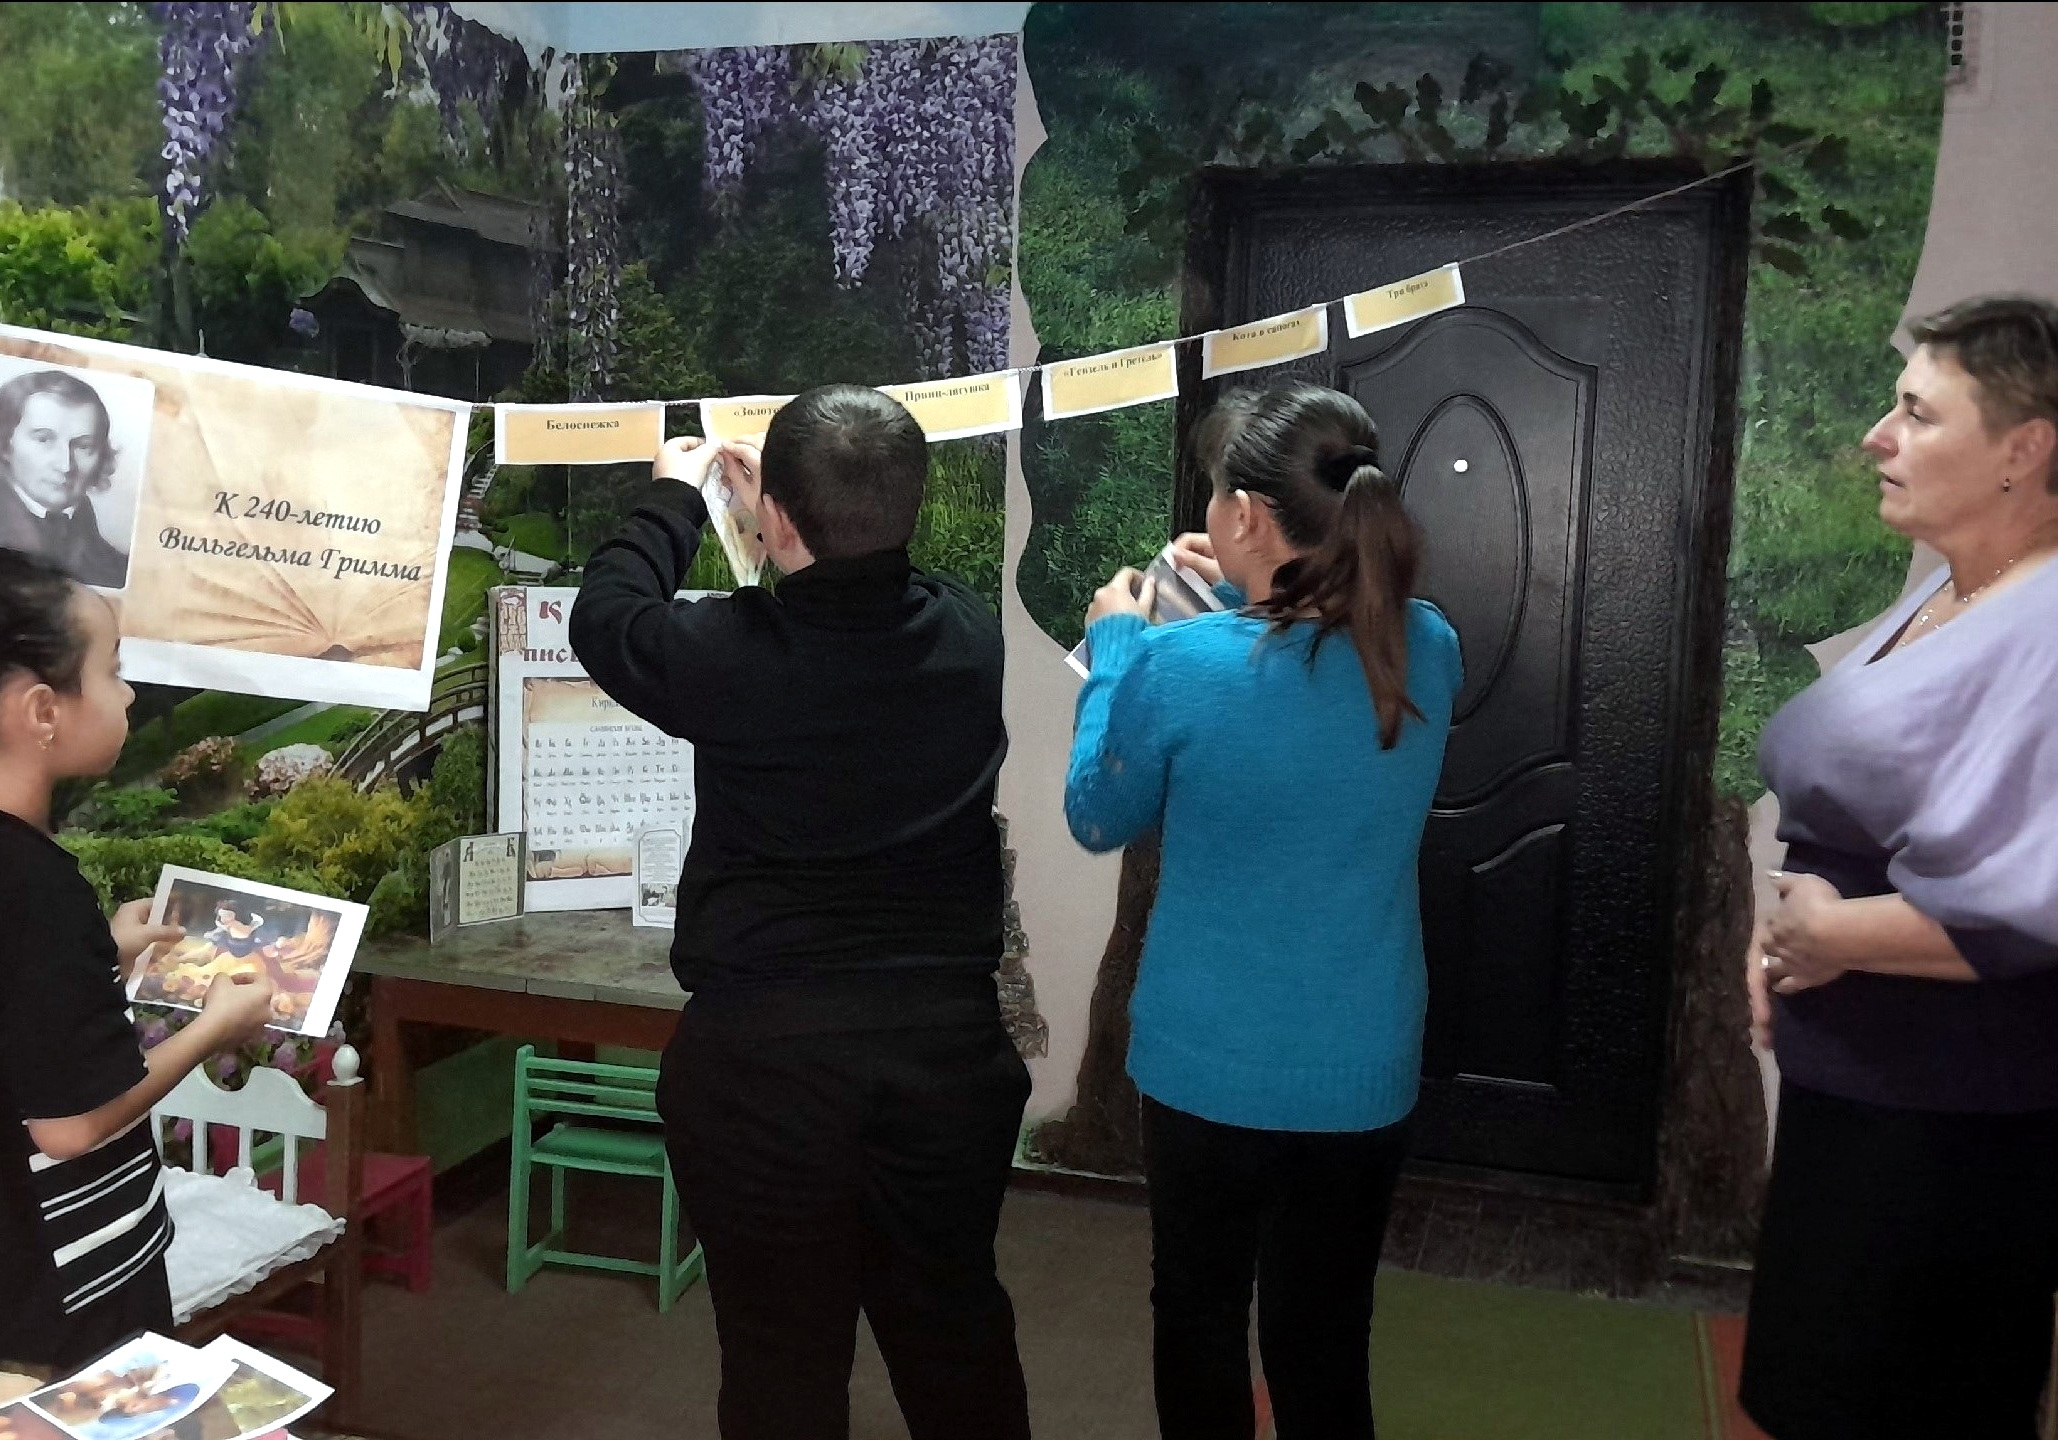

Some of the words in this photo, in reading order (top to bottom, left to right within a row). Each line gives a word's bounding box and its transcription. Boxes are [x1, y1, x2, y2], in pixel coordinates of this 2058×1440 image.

[1111, 361, 1118, 370] и
[546, 419, 620, 431] Белоснежка
[214, 490, 239, 520] К
[243, 496, 382, 535] 240-летию
[158, 526, 312, 568] Вильгельма
[320, 548, 422, 581] Гримма
